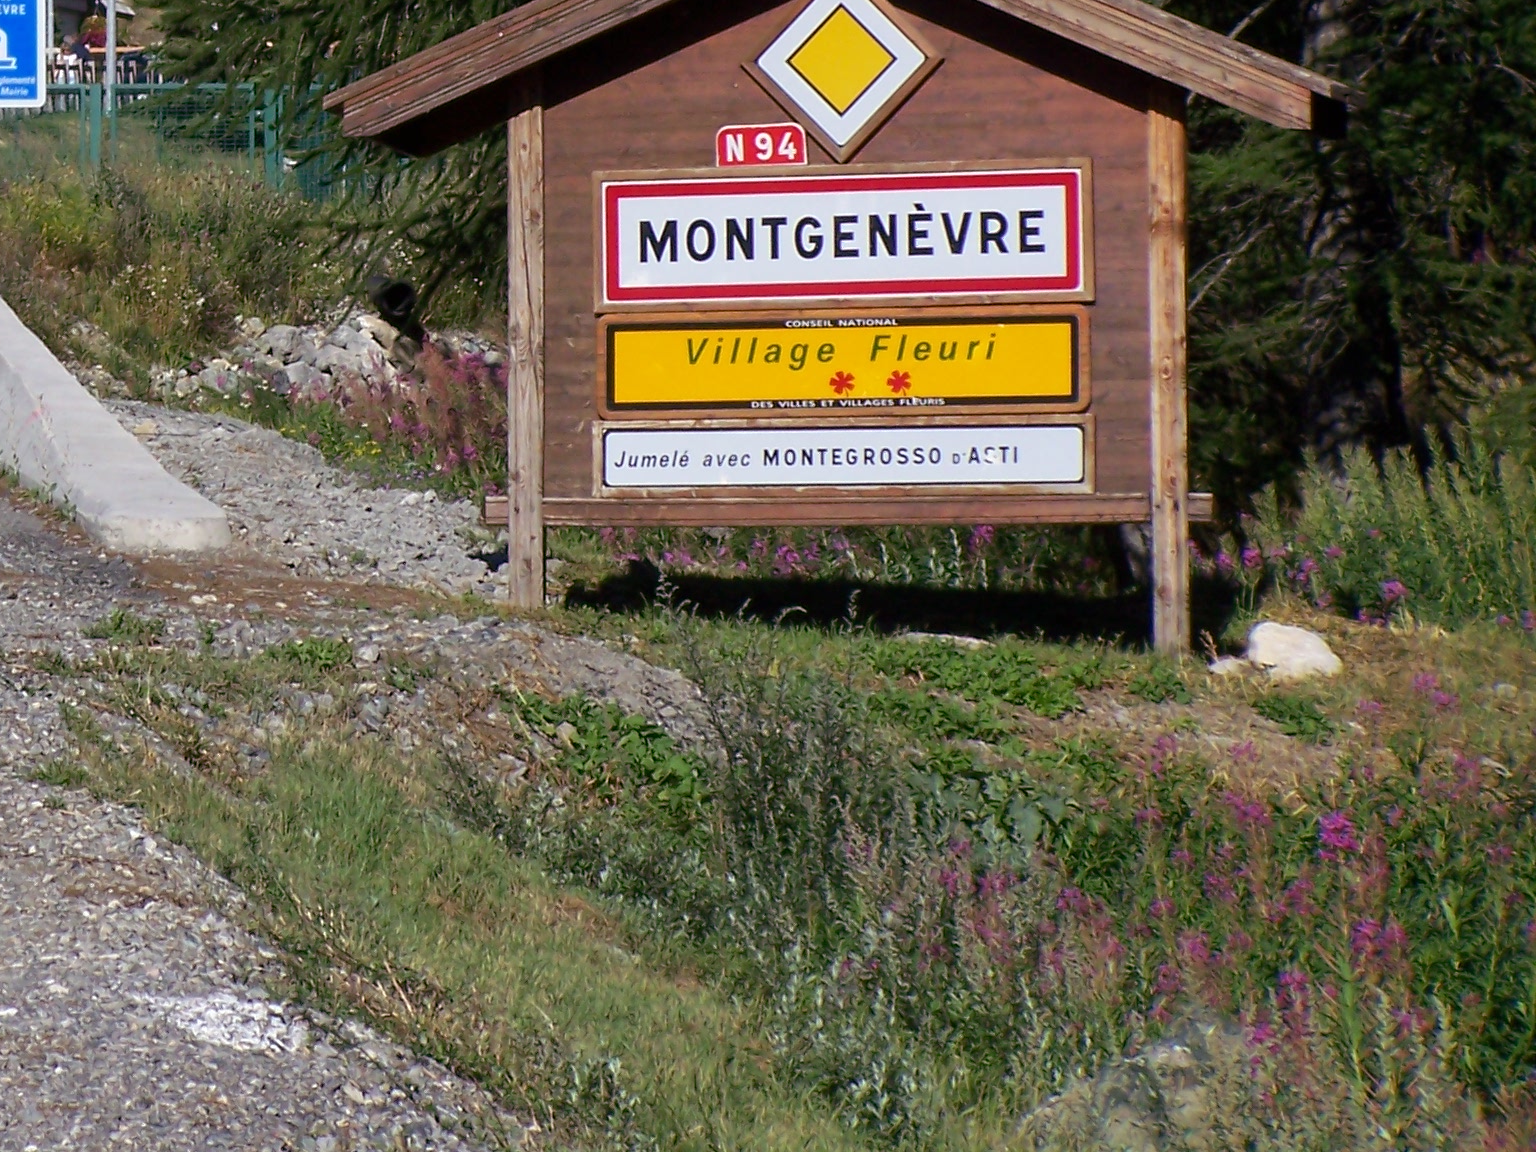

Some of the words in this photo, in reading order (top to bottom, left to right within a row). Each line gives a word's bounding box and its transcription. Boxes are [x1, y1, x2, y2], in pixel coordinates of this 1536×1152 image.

[0, 87, 29, 97] Mairie
[725, 133, 744, 162] N
[754, 131, 797, 161] 94
[638, 203, 1046, 263] MONTGENÈVRE
[785, 319, 834, 328] CONSEIL
[838, 318, 899, 327] NATIONAL
[686, 337, 836, 371] Village
[869, 333, 997, 362] Fleuri
[750, 400, 775, 409] DES
[777, 400, 816, 408] VILLES
[820, 400, 835, 408] ET
[839, 399, 895, 407] VILLAGES
[898, 398, 946, 406] FLEURIS
[614, 450, 690, 468] Jumelé
[702, 452, 751, 468] avec
[763, 447, 942, 467] MONTEGROSSO
